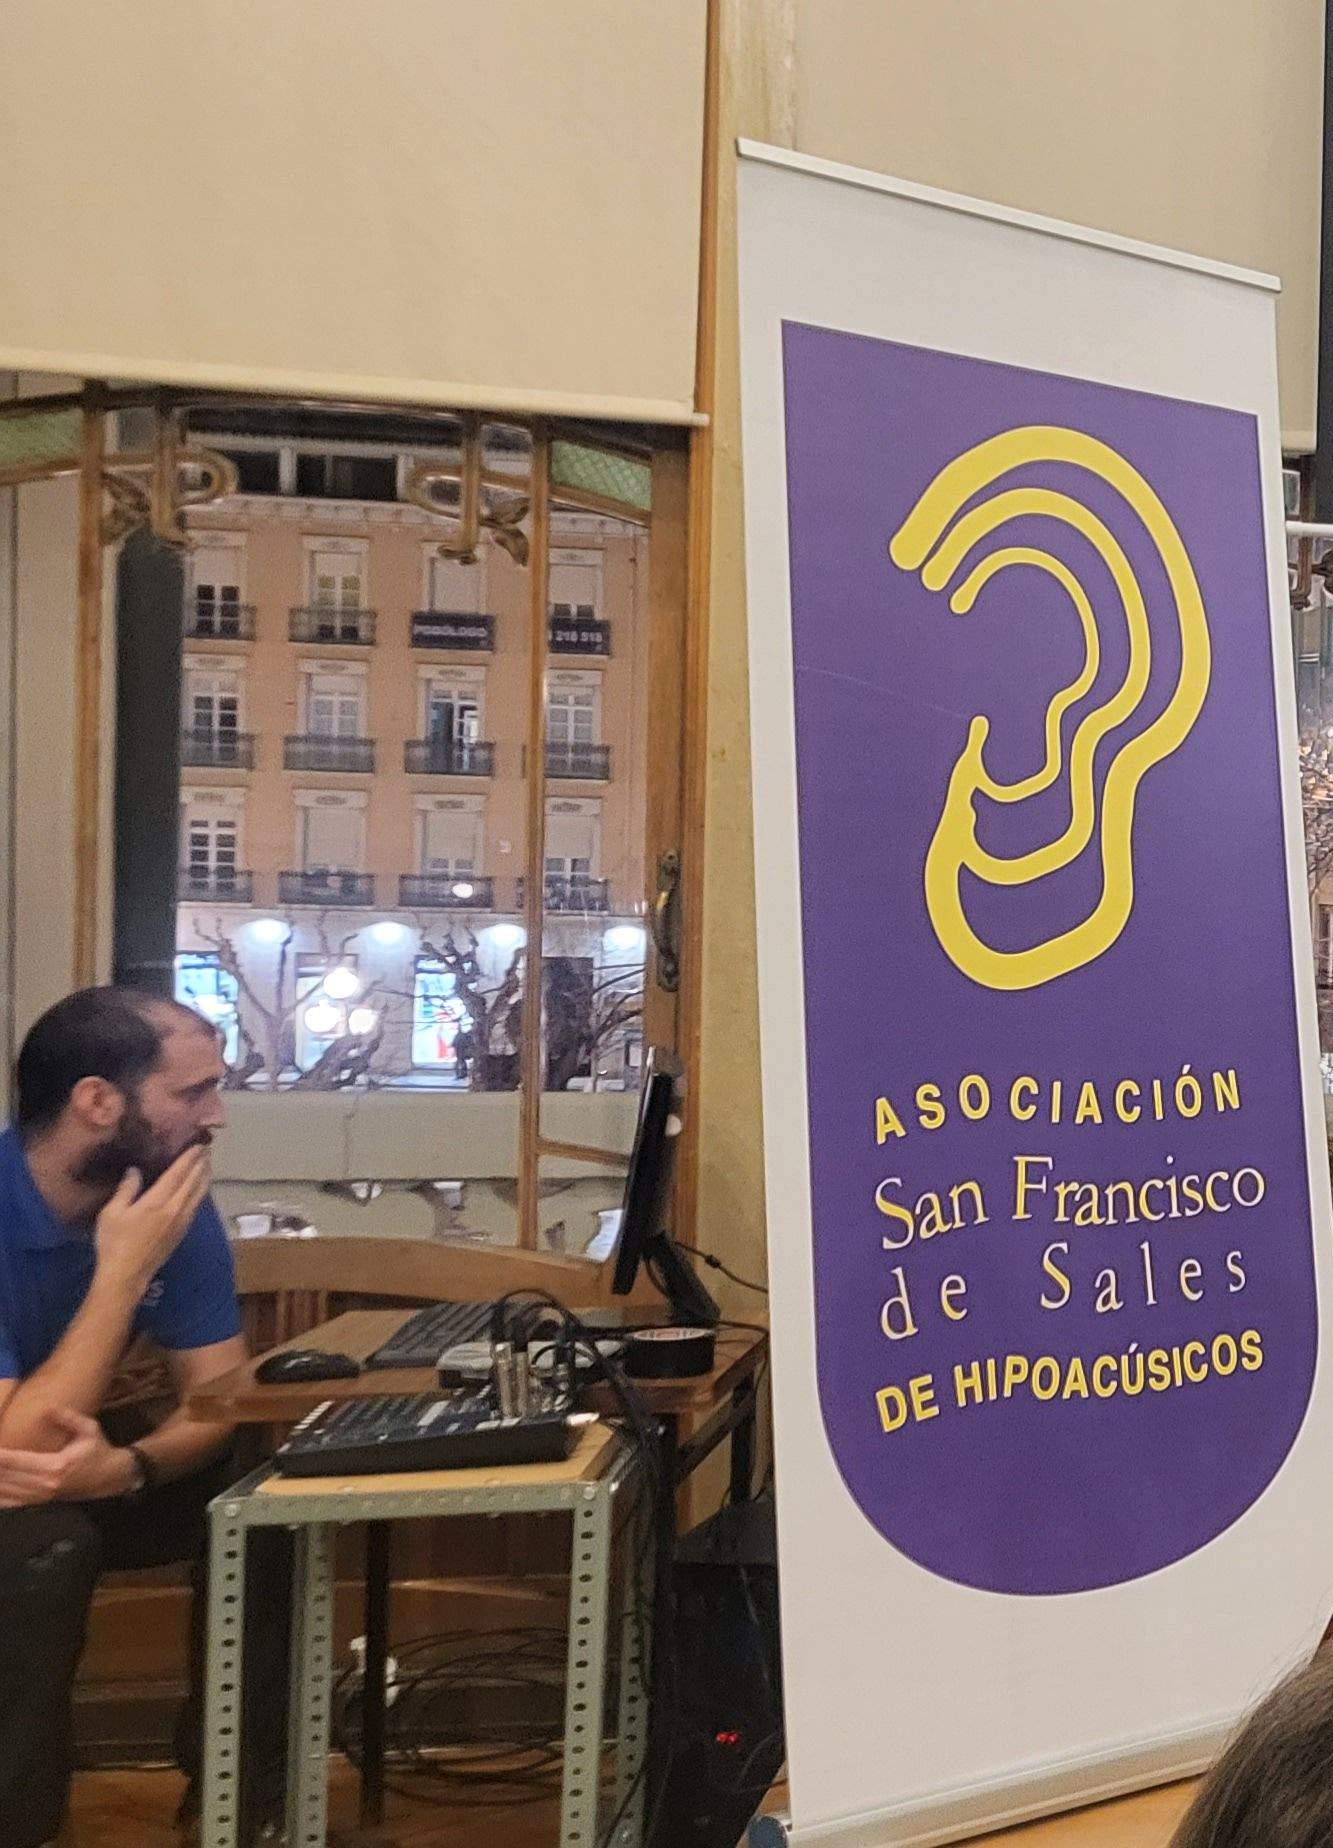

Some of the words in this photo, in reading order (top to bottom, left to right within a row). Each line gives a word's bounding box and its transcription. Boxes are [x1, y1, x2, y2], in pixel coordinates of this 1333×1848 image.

[874, 1064, 1241, 1145] ASOCIACIÓN
[874, 1177, 990, 1249] San
[1011, 1155, 1266, 1227] Francisco
[880, 1267, 969, 1340] de
[1040, 1240, 1247, 1314] Sales
[875, 1374, 940, 1433] DE
[954, 1329, 1264, 1407] HIPOACÚSICOS
